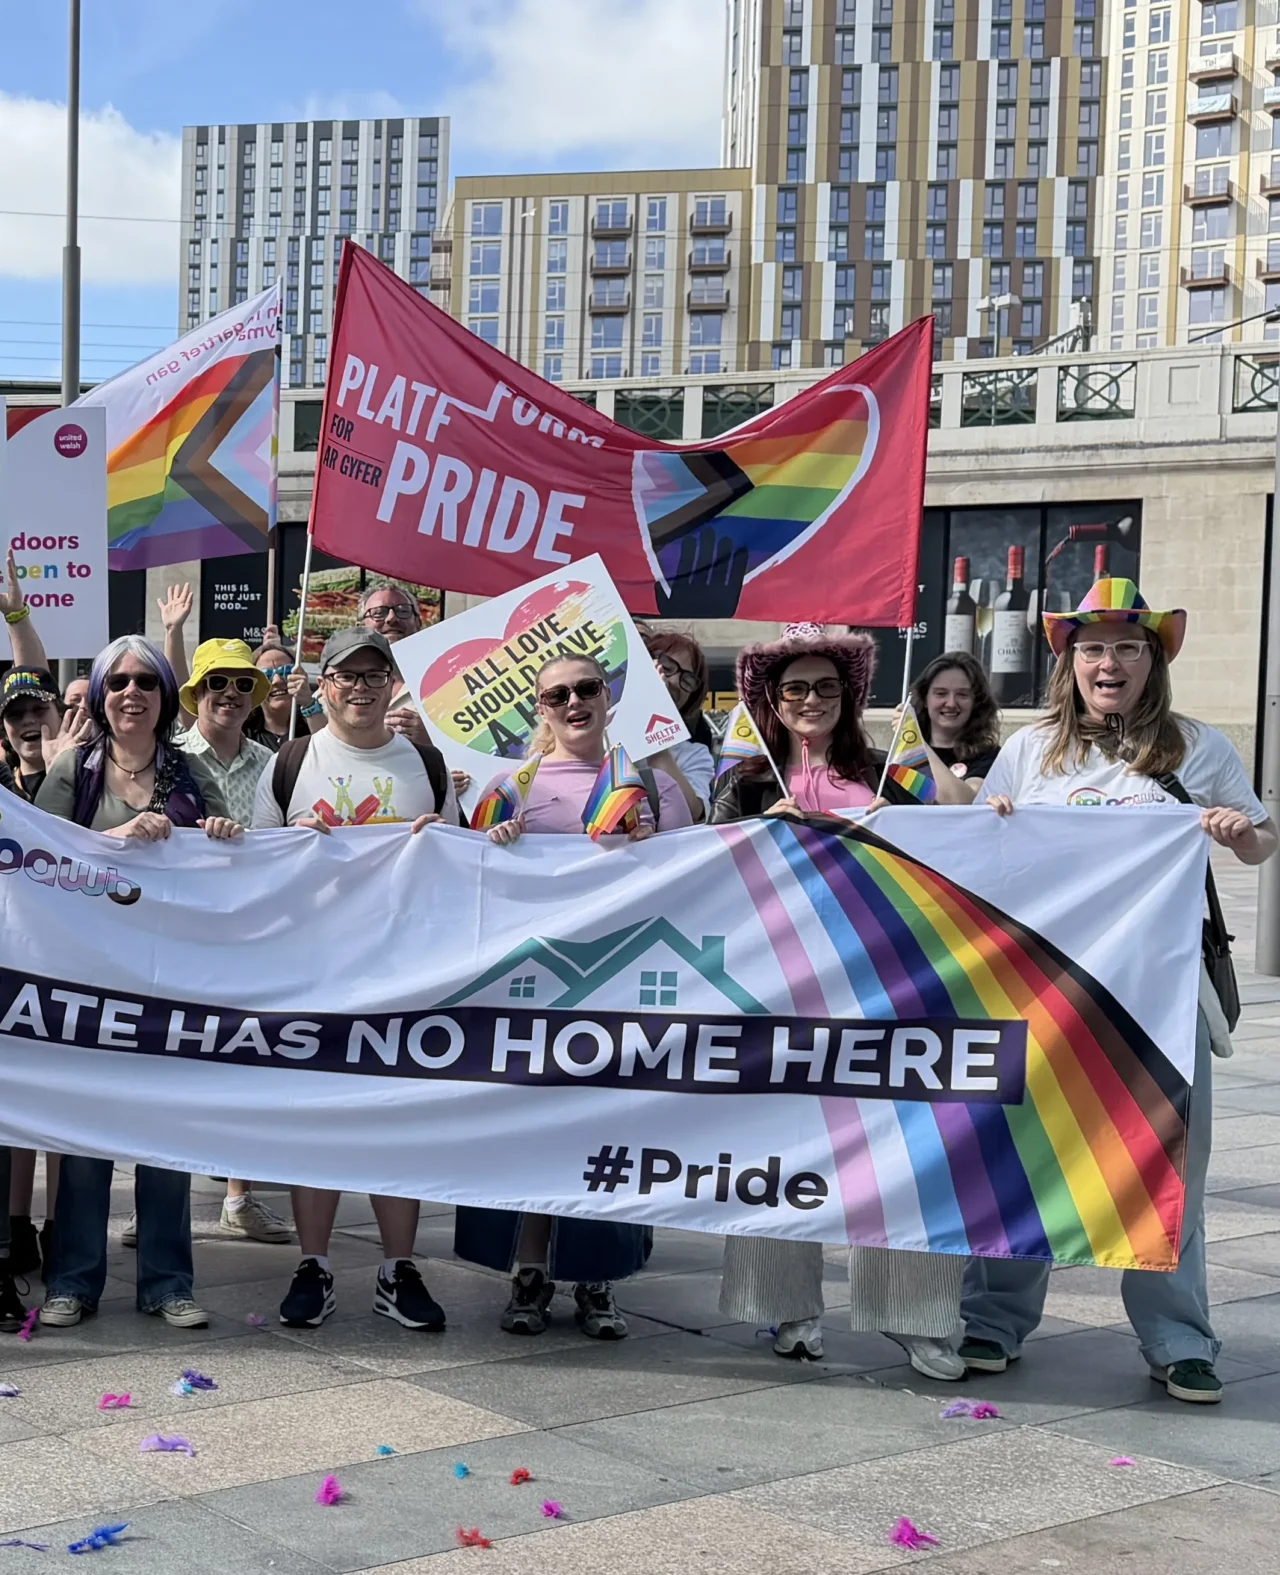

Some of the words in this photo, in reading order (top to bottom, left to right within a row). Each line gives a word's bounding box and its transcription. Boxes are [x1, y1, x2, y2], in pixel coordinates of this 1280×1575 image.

[59, 433, 82, 442] united
[330, 413, 355, 442] FOR
[59, 442, 81, 450] welsh
[322, 446, 336, 471] AR
[340, 454, 383, 488] GYFER
[376, 440, 586, 565] PRIDE
[11, 532, 79, 550] doors
[15, 563, 58, 580] pen
[66, 561, 91, 578] to
[214, 593, 234, 601] NOT
[237, 593, 262, 601] JUST
[215, 584, 237, 592] THIS
[240, 584, 249, 592] IS
[462, 658, 509, 696] ALL
[503, 612, 568, 664] LOVE
[453, 662, 538, 733] SHOULD
[487, 717, 525, 757] A
[645, 723, 682, 745] SHELTER
[165, 1009, 322, 1060] HAS
[346, 1014, 466, 1070] NO
[490, 1016, 743, 1084] HOME
[769, 1025, 1001, 1091] HERE
[582, 1144, 830, 1211] #Pride
